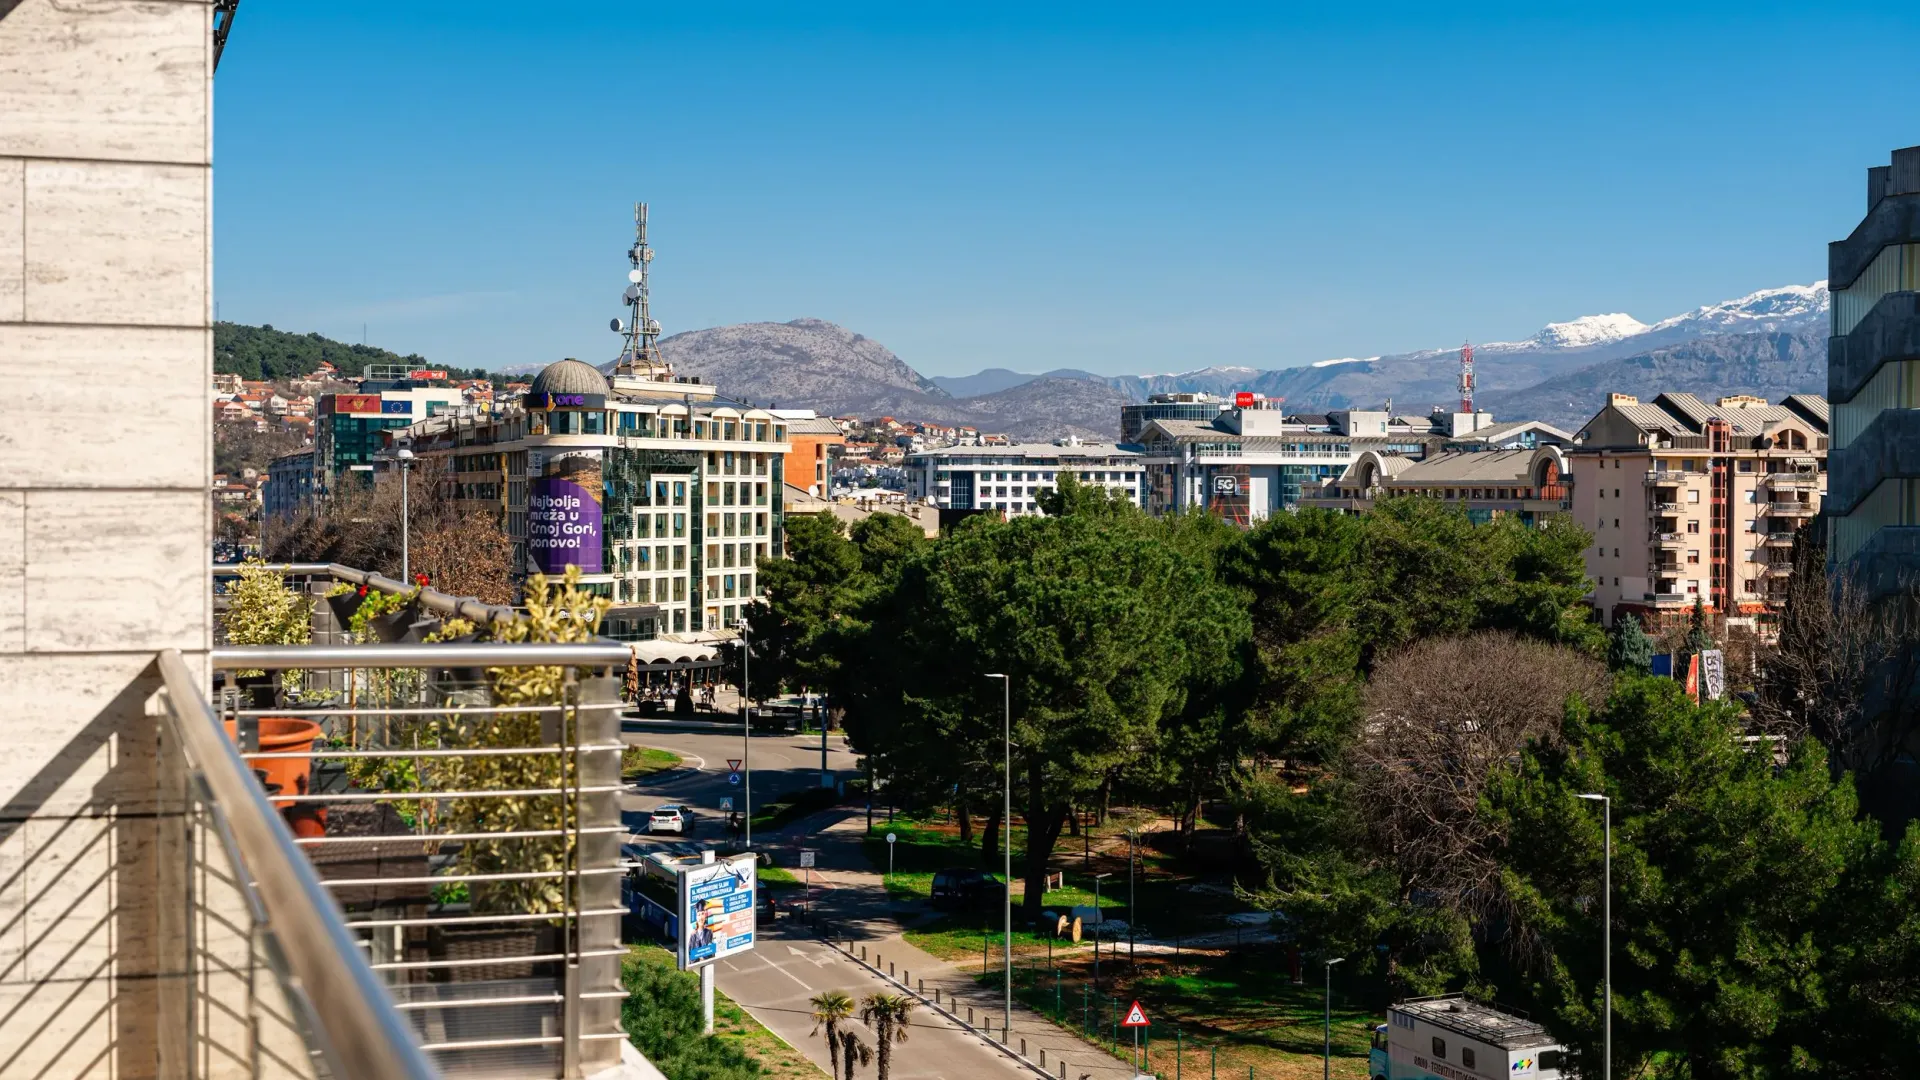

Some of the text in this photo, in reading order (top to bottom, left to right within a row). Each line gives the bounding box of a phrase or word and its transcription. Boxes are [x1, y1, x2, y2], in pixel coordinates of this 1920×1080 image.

[555, 394, 585, 406] one
[1217, 479, 1234, 490] 5G
[530, 495, 580, 511] Najbolja
[530, 509, 579, 521] mreža u
[530, 522, 597, 537] Crnoj Gori,
[530, 537, 581, 550] ponovo!
